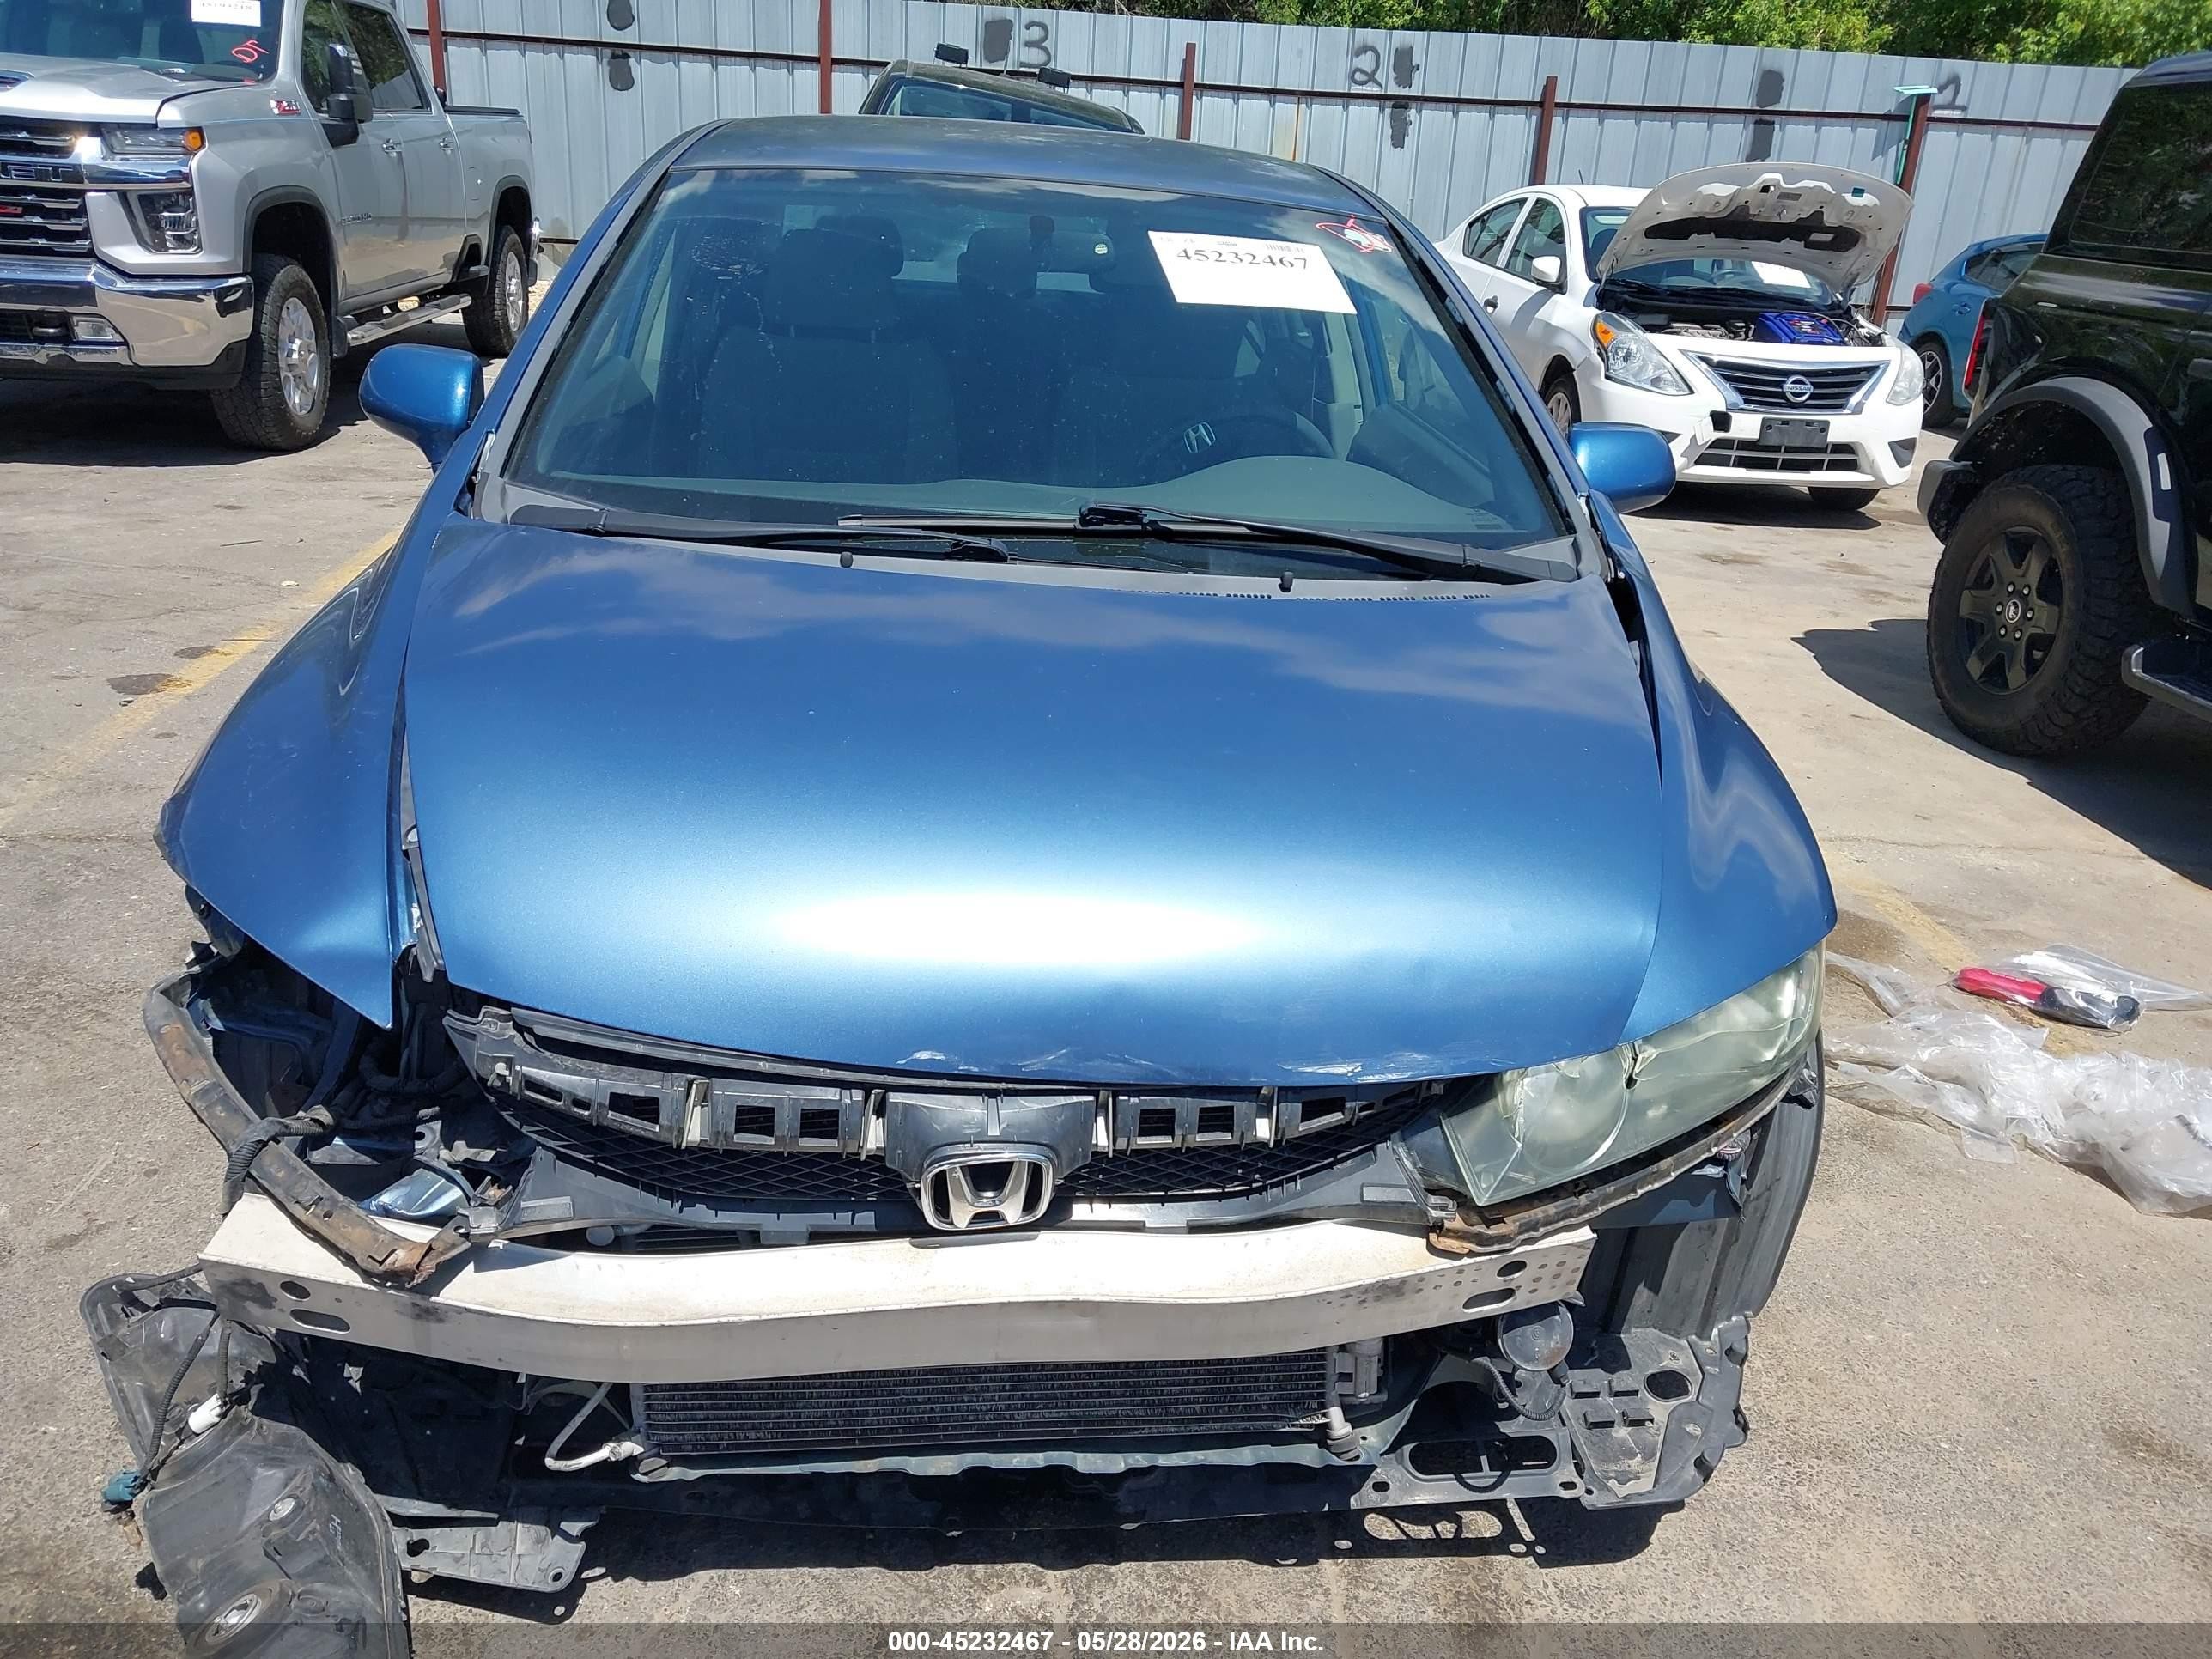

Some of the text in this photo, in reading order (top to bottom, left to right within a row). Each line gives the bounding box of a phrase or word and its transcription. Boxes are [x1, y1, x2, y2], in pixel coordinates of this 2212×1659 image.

[1019, 21, 1052, 69] 3
[1350, 45, 1383, 89] 2
[1176, 247, 1308, 270] 45232467
